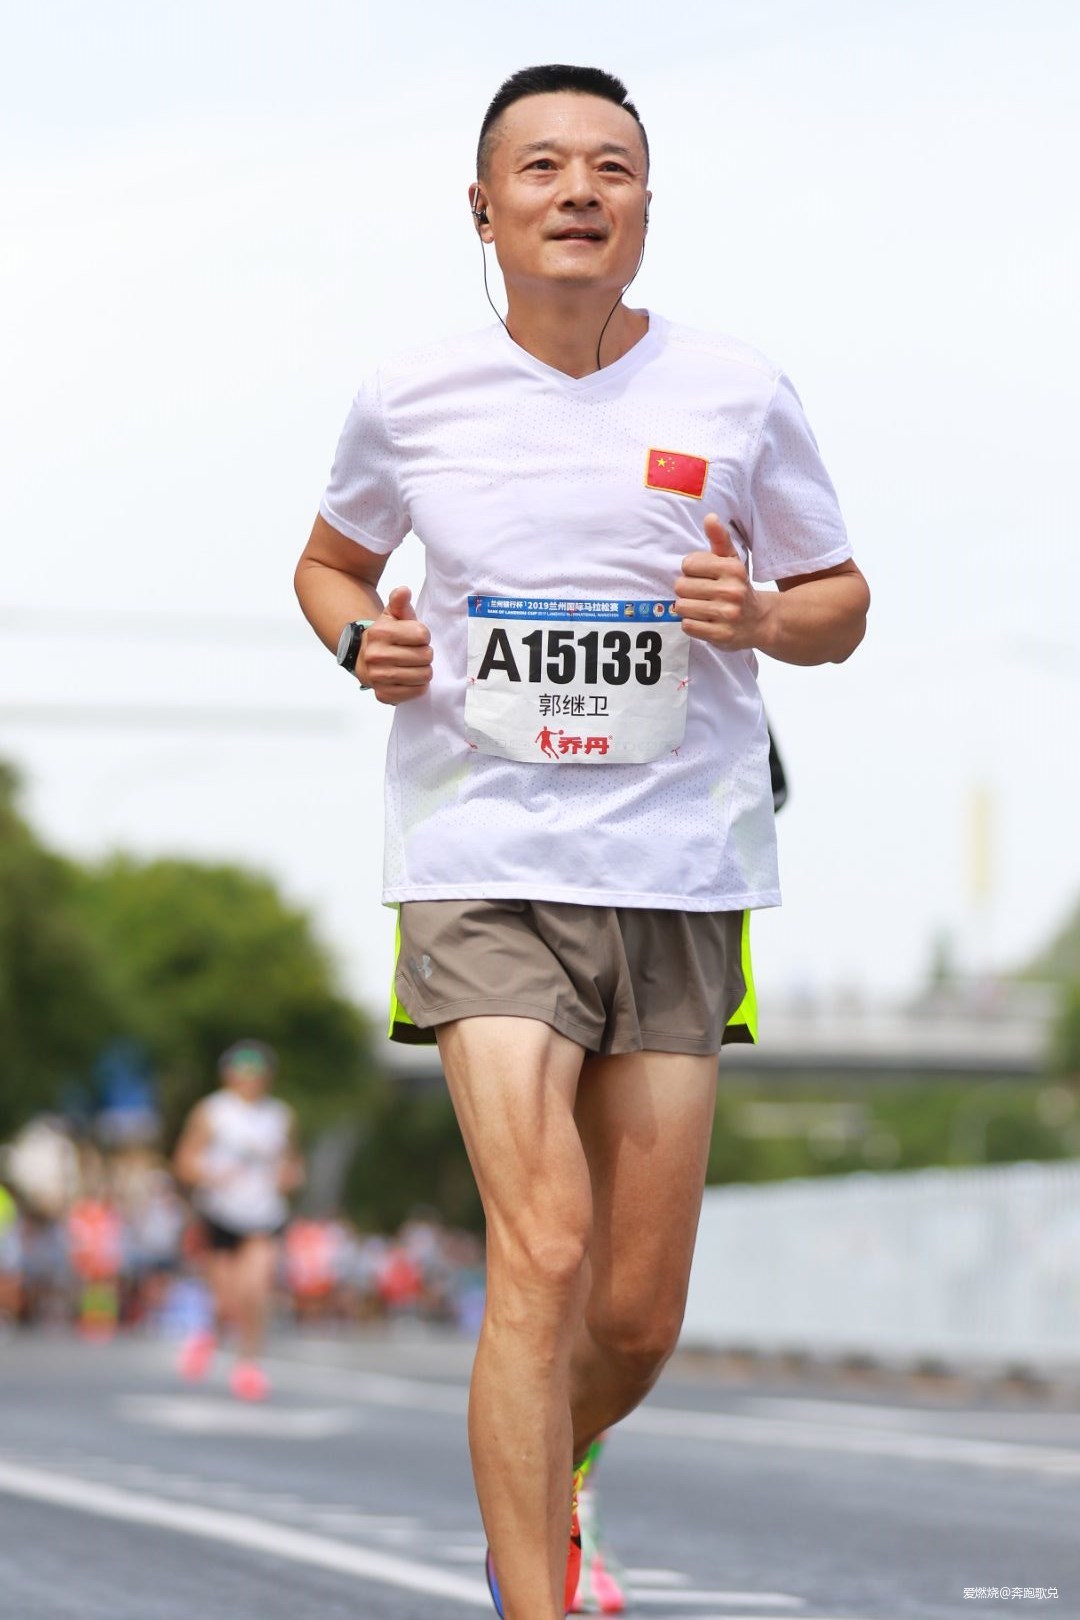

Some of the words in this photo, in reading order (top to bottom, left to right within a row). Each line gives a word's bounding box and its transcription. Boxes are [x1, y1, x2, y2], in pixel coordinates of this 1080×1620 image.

[477, 627, 663, 686] A15133
[538, 693, 610, 717] 郭继卫
[557, 736, 610, 755] 乔丹
